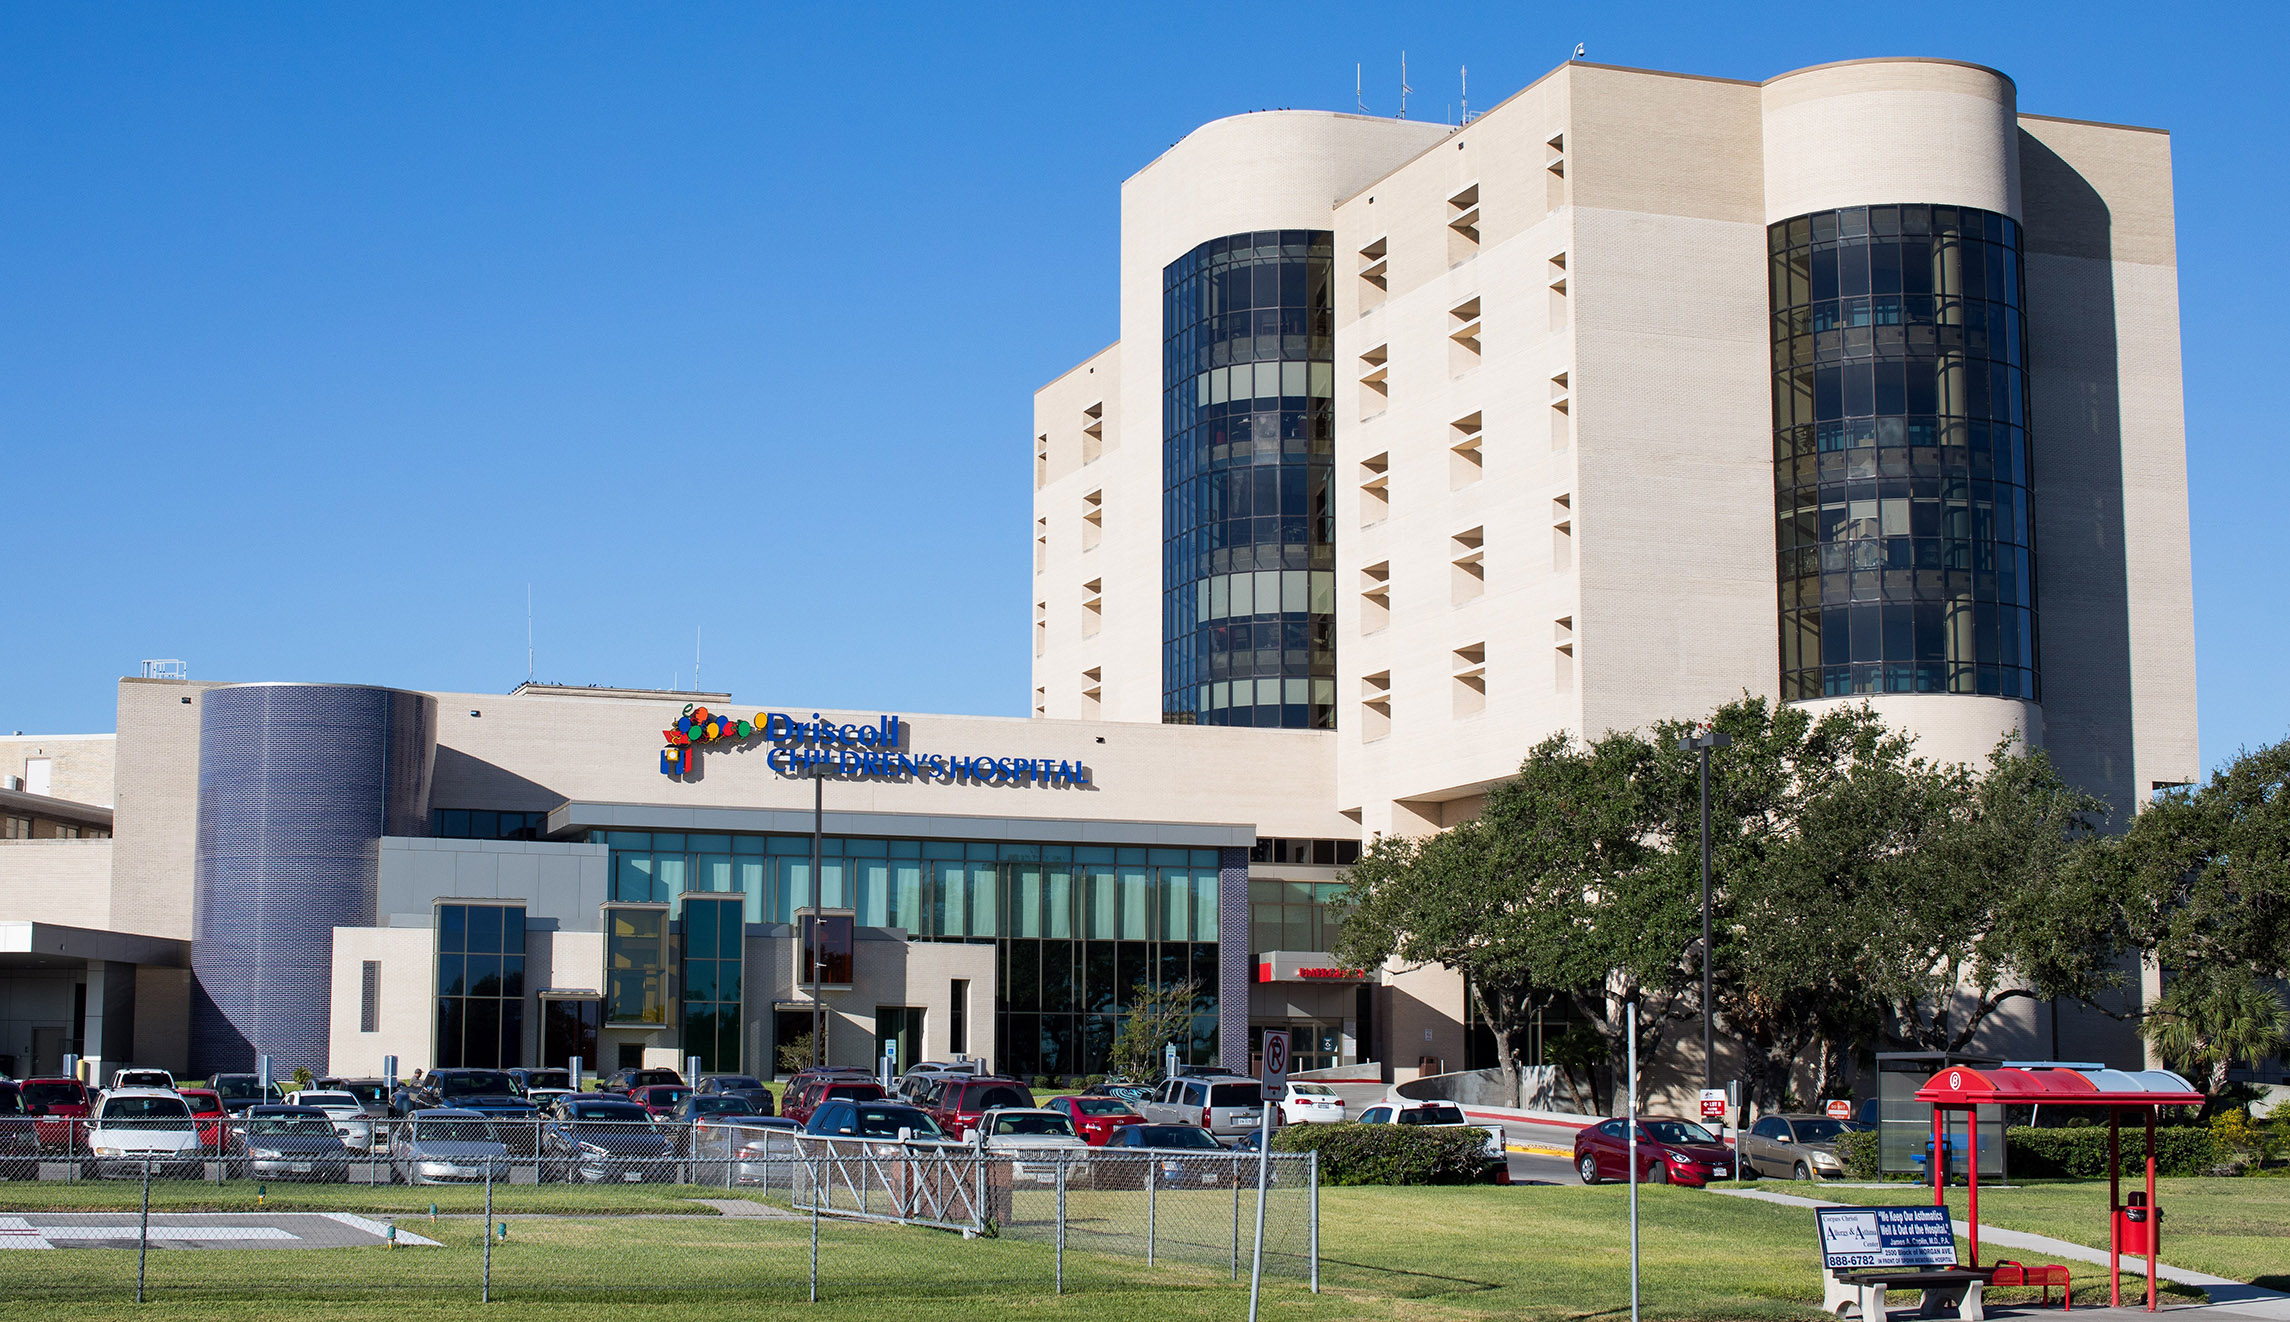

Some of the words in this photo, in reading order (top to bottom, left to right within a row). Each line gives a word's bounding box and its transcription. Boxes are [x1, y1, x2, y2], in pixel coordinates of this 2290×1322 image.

[766, 712, 898, 747] Driscoll
[766, 747, 944, 778] CHILDREN'S
[950, 755, 1089, 784] HOSPITAL
[1888, 1211, 1904, 1224] Keep
[1903, 1210, 1914, 1221] Our
[1914, 1210, 1944, 1221] Asthmatics
[1827, 1225, 1848, 1240] Allergy
[1849, 1227, 1855, 1235] &
[1855, 1225, 1877, 1240] Asthma
[1880, 1224, 1892, 1236] Well
[1892, 1224, 1898, 1235] &
[1897, 1224, 1908, 1235] Out
[1908, 1224, 1914, 1235] of
[1914, 1224, 1924, 1235] the
[1890, 1238, 1906, 1246] James
[1829, 1255, 1875, 1266] 888-6782
